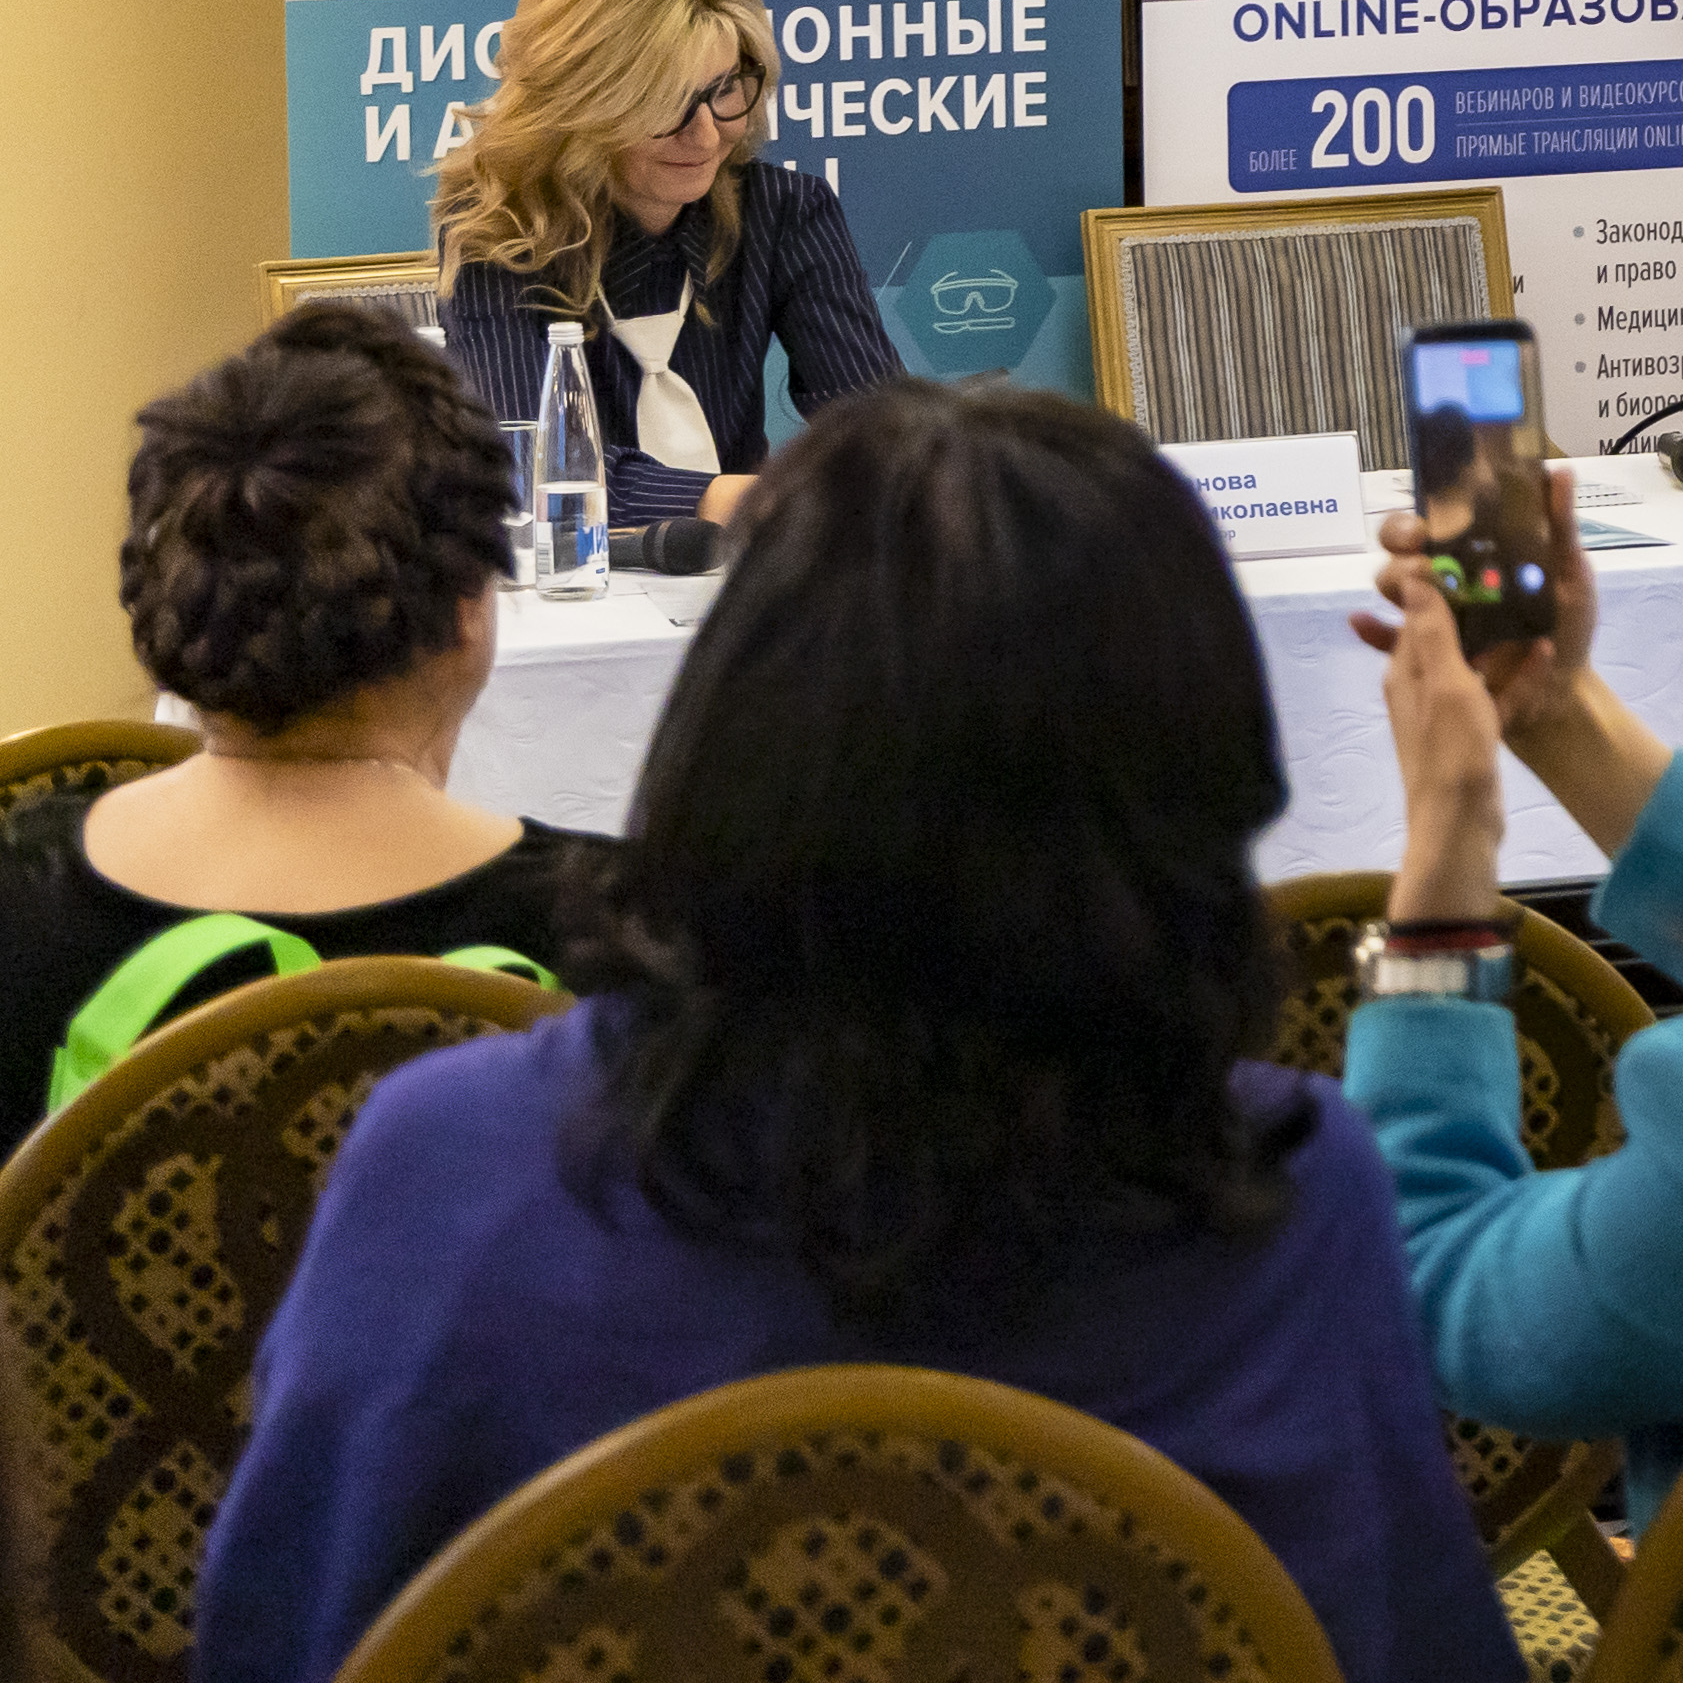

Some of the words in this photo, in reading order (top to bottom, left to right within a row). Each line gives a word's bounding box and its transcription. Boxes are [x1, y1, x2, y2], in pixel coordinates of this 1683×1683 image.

[1455, 85, 1555, 116] ВЕБИНАРОВ
[1561, 85, 1572, 108] И
[364, 103, 413, 164] И
[1249, 148, 1299, 175] БОЛЕЕ
[1310, 84, 1436, 170] 200
[1455, 130, 1528, 160] ПРЯМЫЕ
[1531, 125, 1640, 157] ТРАНСЛЯЦИИ
[1596, 261, 1609, 285] и
[1614, 256, 1678, 287] право
[1598, 397, 1609, 418] и
